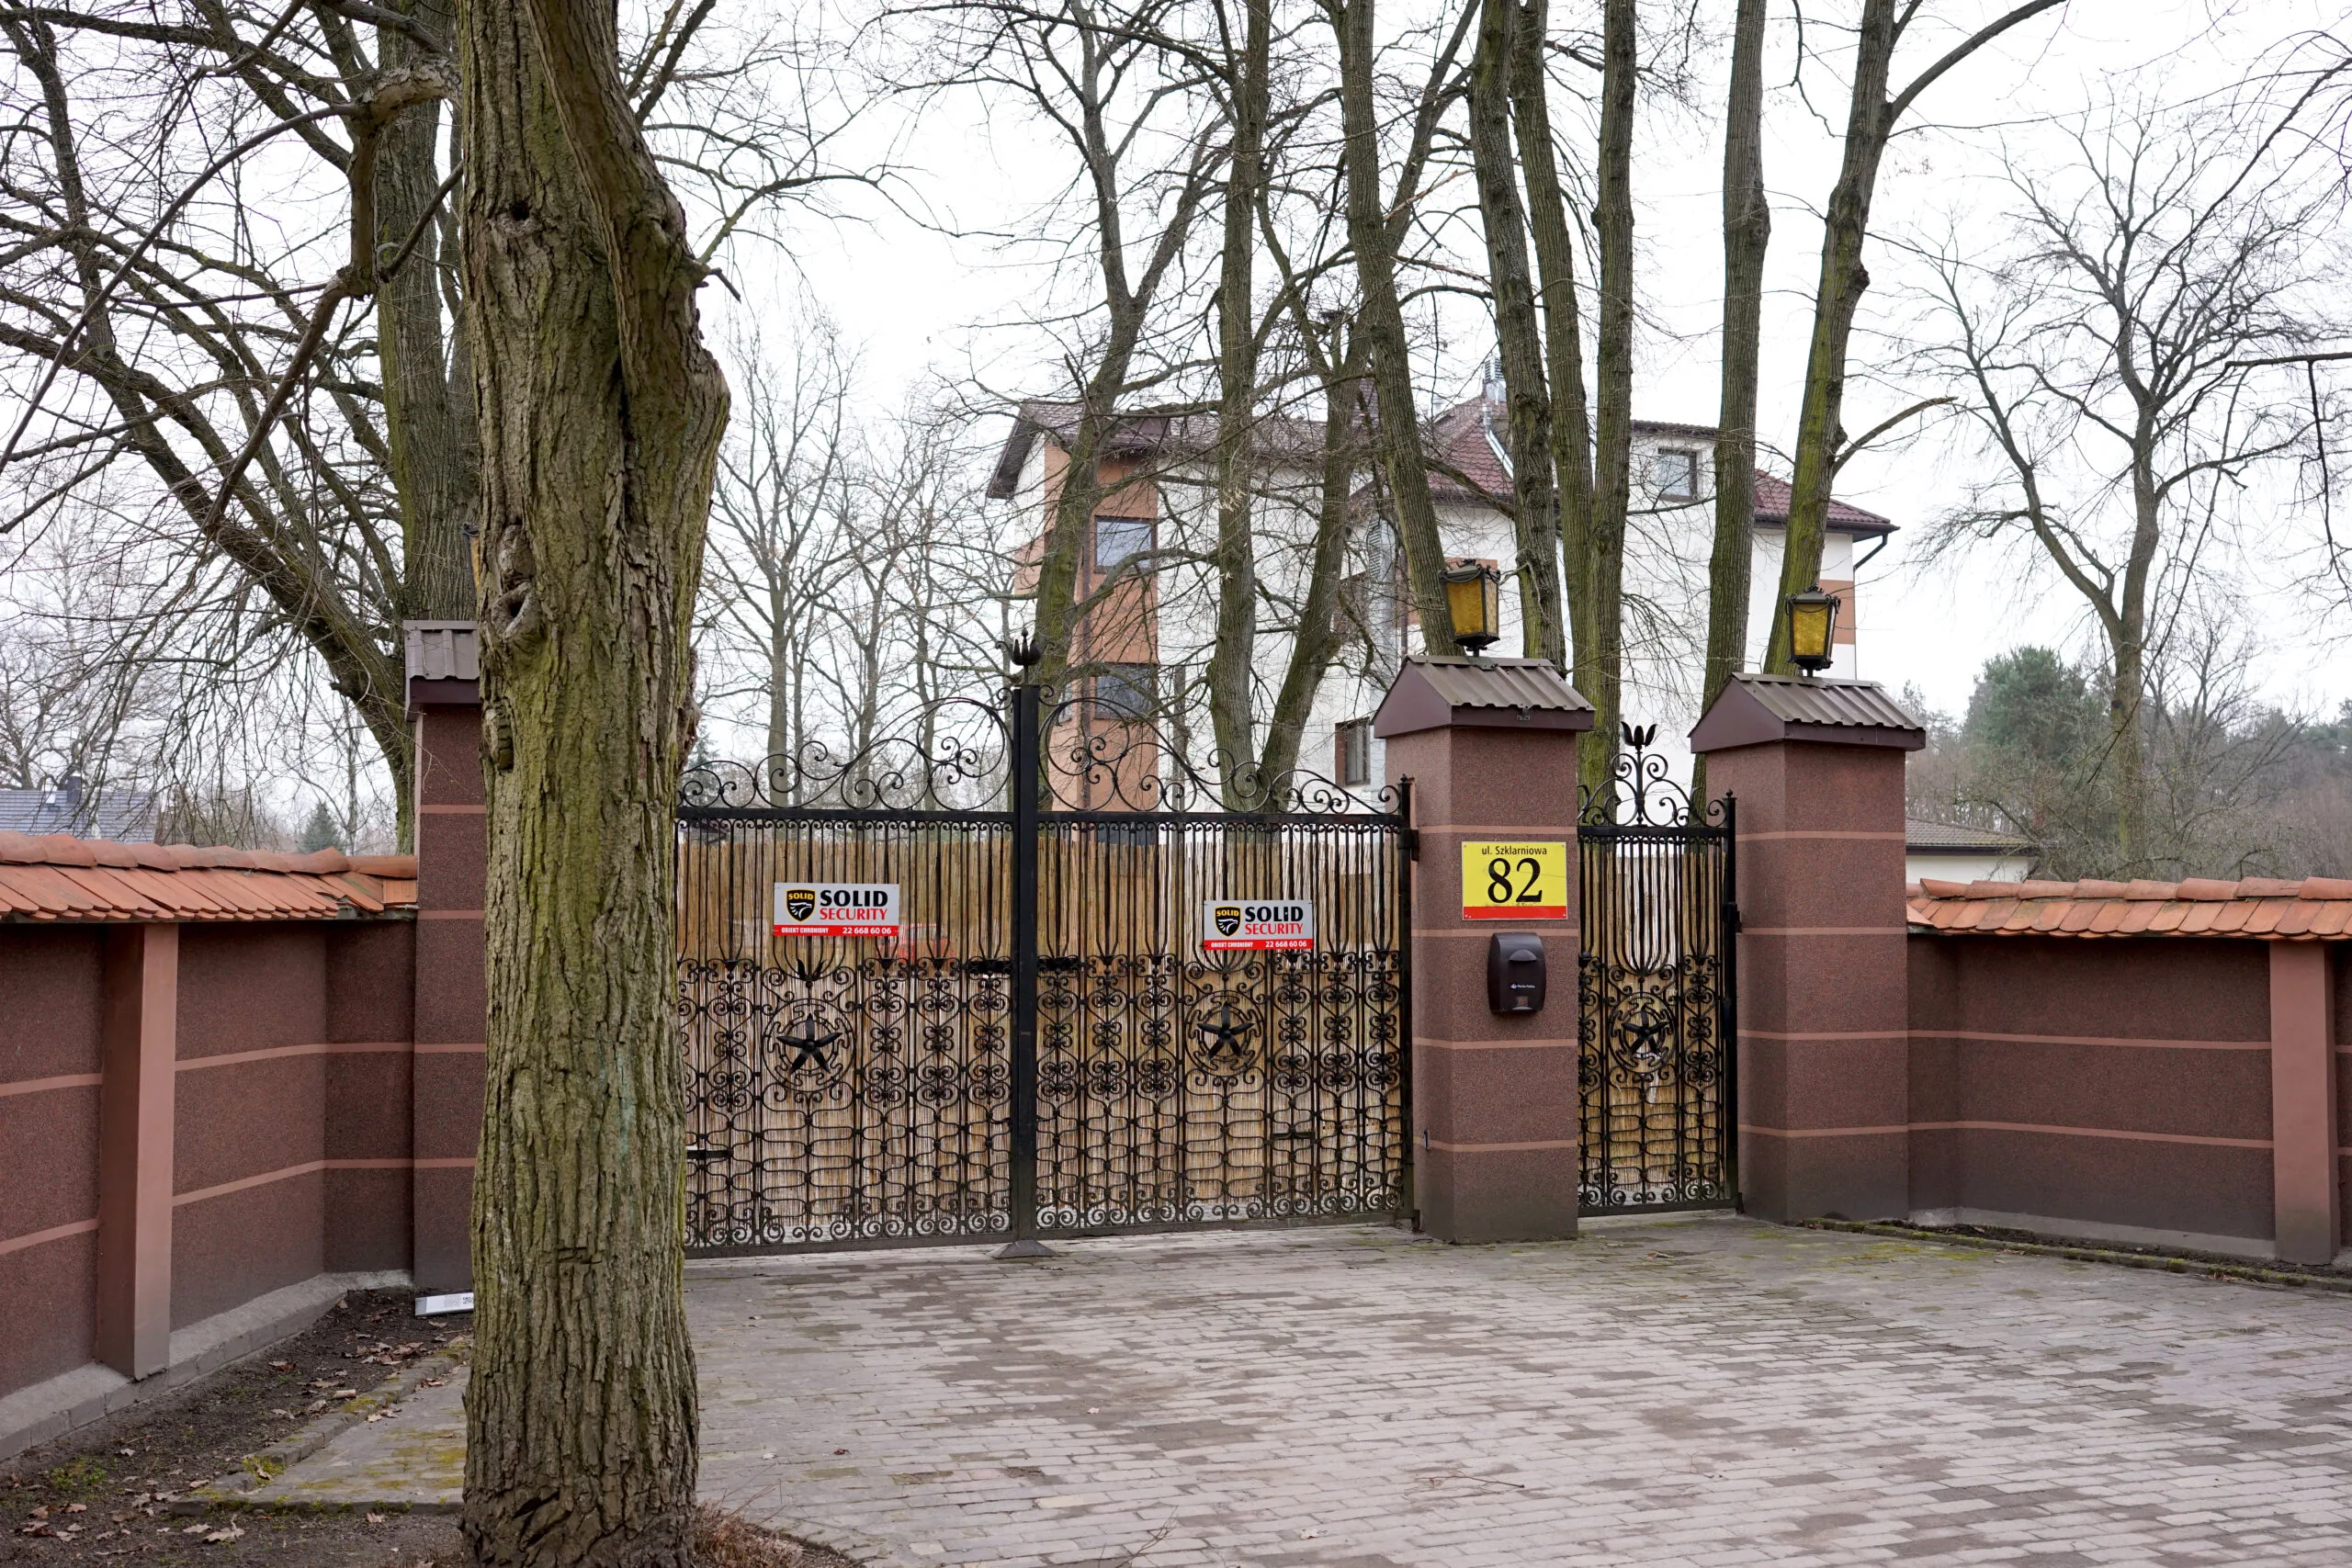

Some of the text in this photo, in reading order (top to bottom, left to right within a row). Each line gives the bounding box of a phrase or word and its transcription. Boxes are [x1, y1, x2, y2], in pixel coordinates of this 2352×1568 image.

[1481, 845, 1547, 855] ul. Szklarniowa
[1487, 857, 1543, 903] 82
[788, 892, 814, 900] SOLID
[820, 889, 888, 908] SOLID
[820, 908, 888, 920] SECURITY
[1245, 906, 1304, 922] SOLID
[854, 927, 869, 935] 668
[870, 927, 880, 935] 60
[881, 927, 891, 935] 06
[1245, 922, 1304, 935] SECURITY
